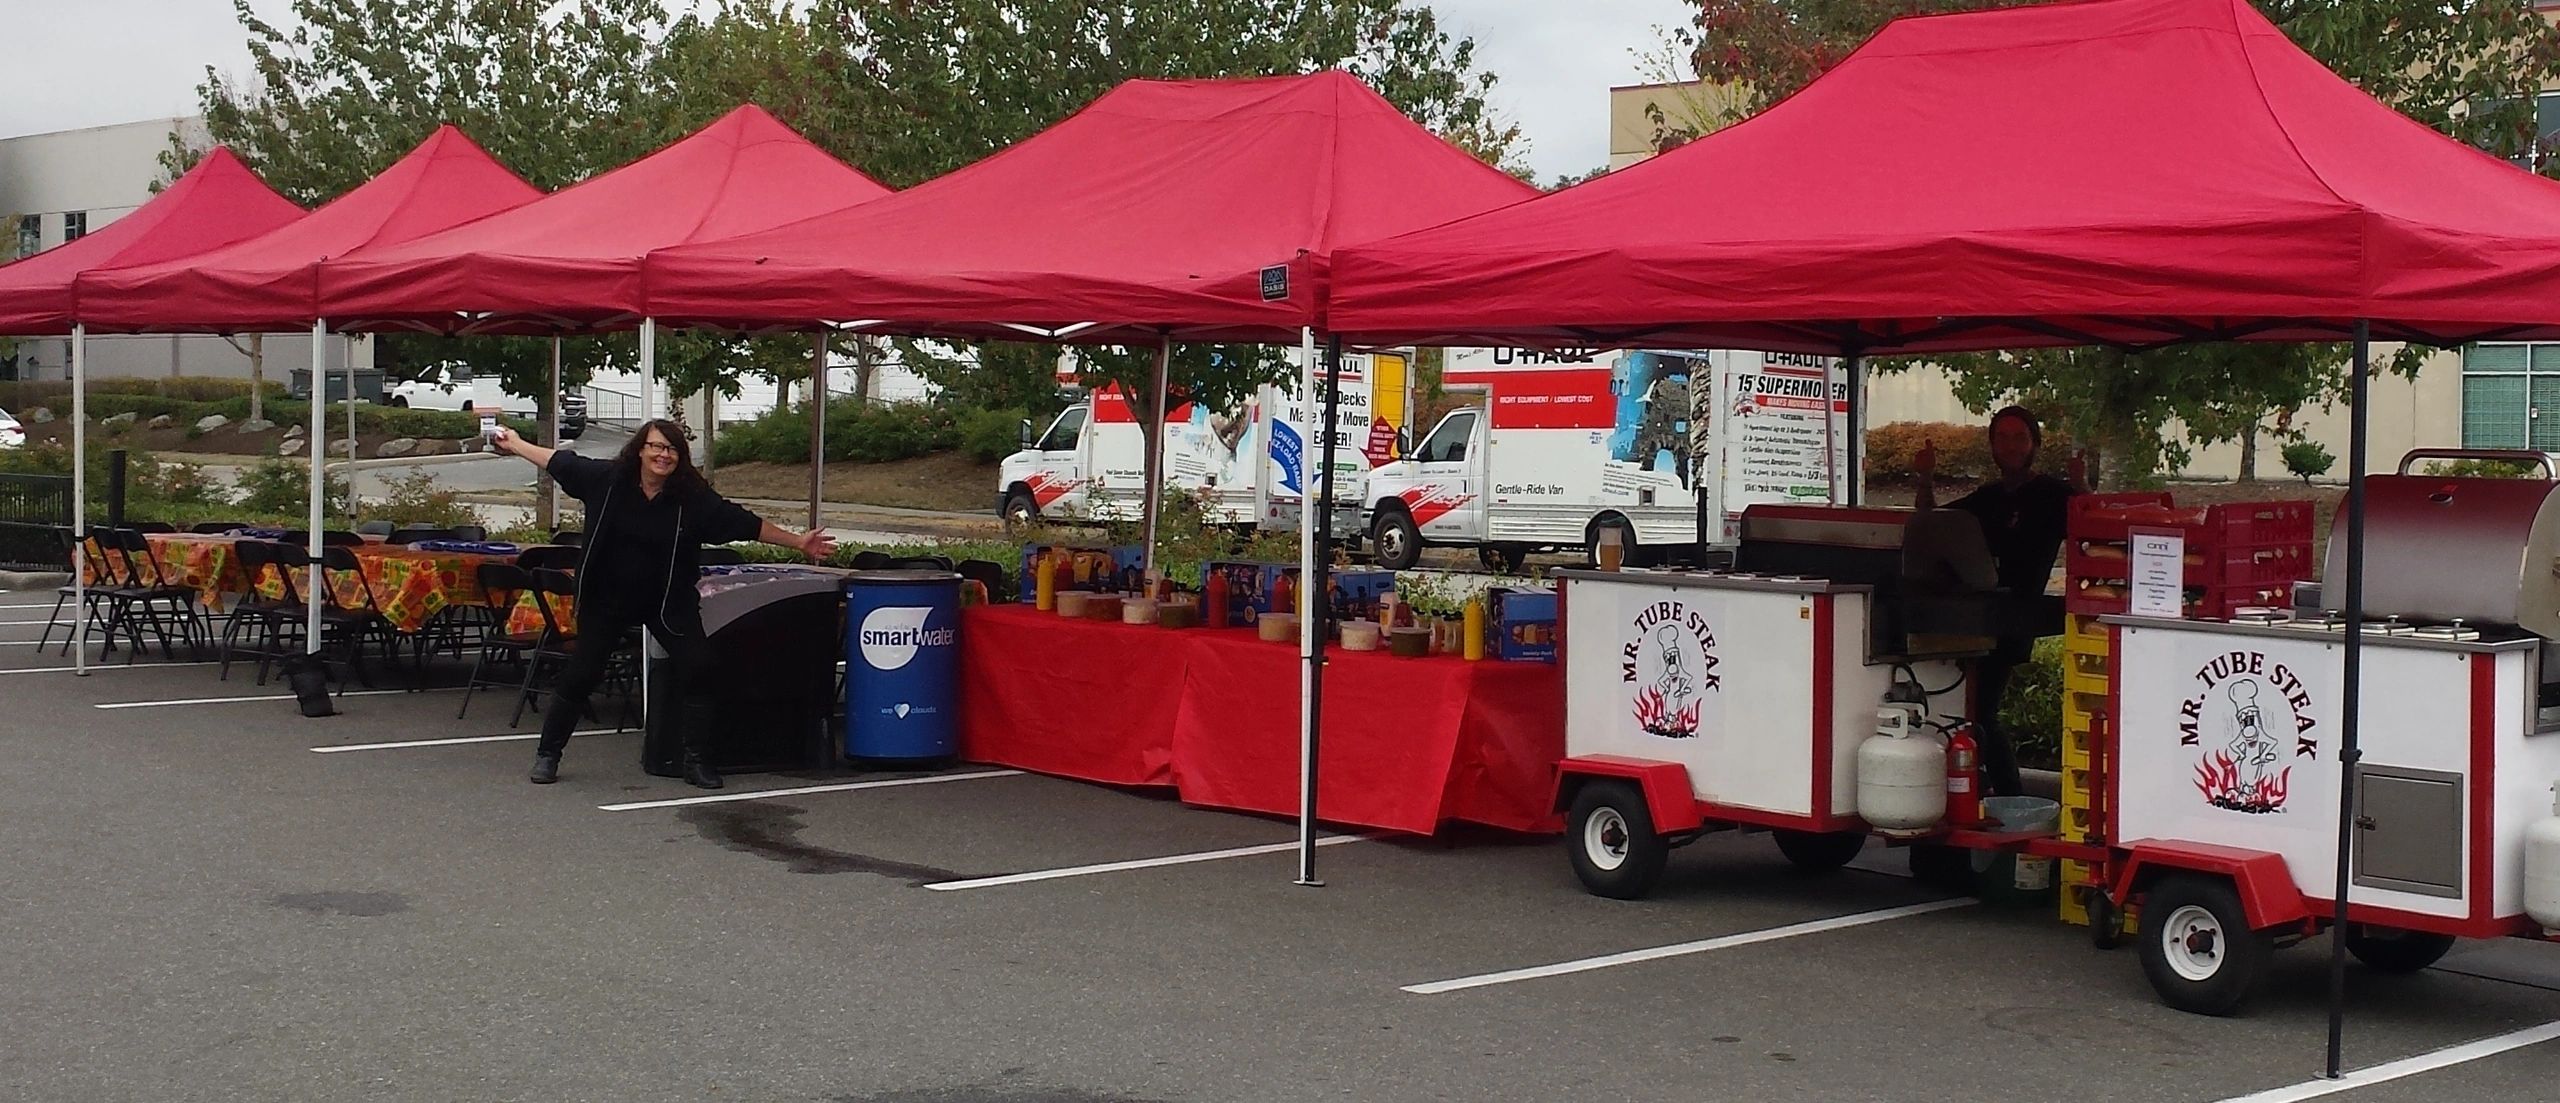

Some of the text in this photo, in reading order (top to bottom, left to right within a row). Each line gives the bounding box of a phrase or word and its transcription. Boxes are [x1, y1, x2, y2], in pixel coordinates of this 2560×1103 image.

[1757, 375, 1848, 400] SUPERMOER
[1337, 391, 1367, 407] Decks
[1343, 411, 1369, 427] Move
[1495, 483, 1564, 495] Gentle-Ride Van
[863, 627, 955, 647] smartwater
[1623, 601, 1721, 693] MR. TUBE STEAK
[2179, 651, 2318, 761] MR. TUBE STEAK
